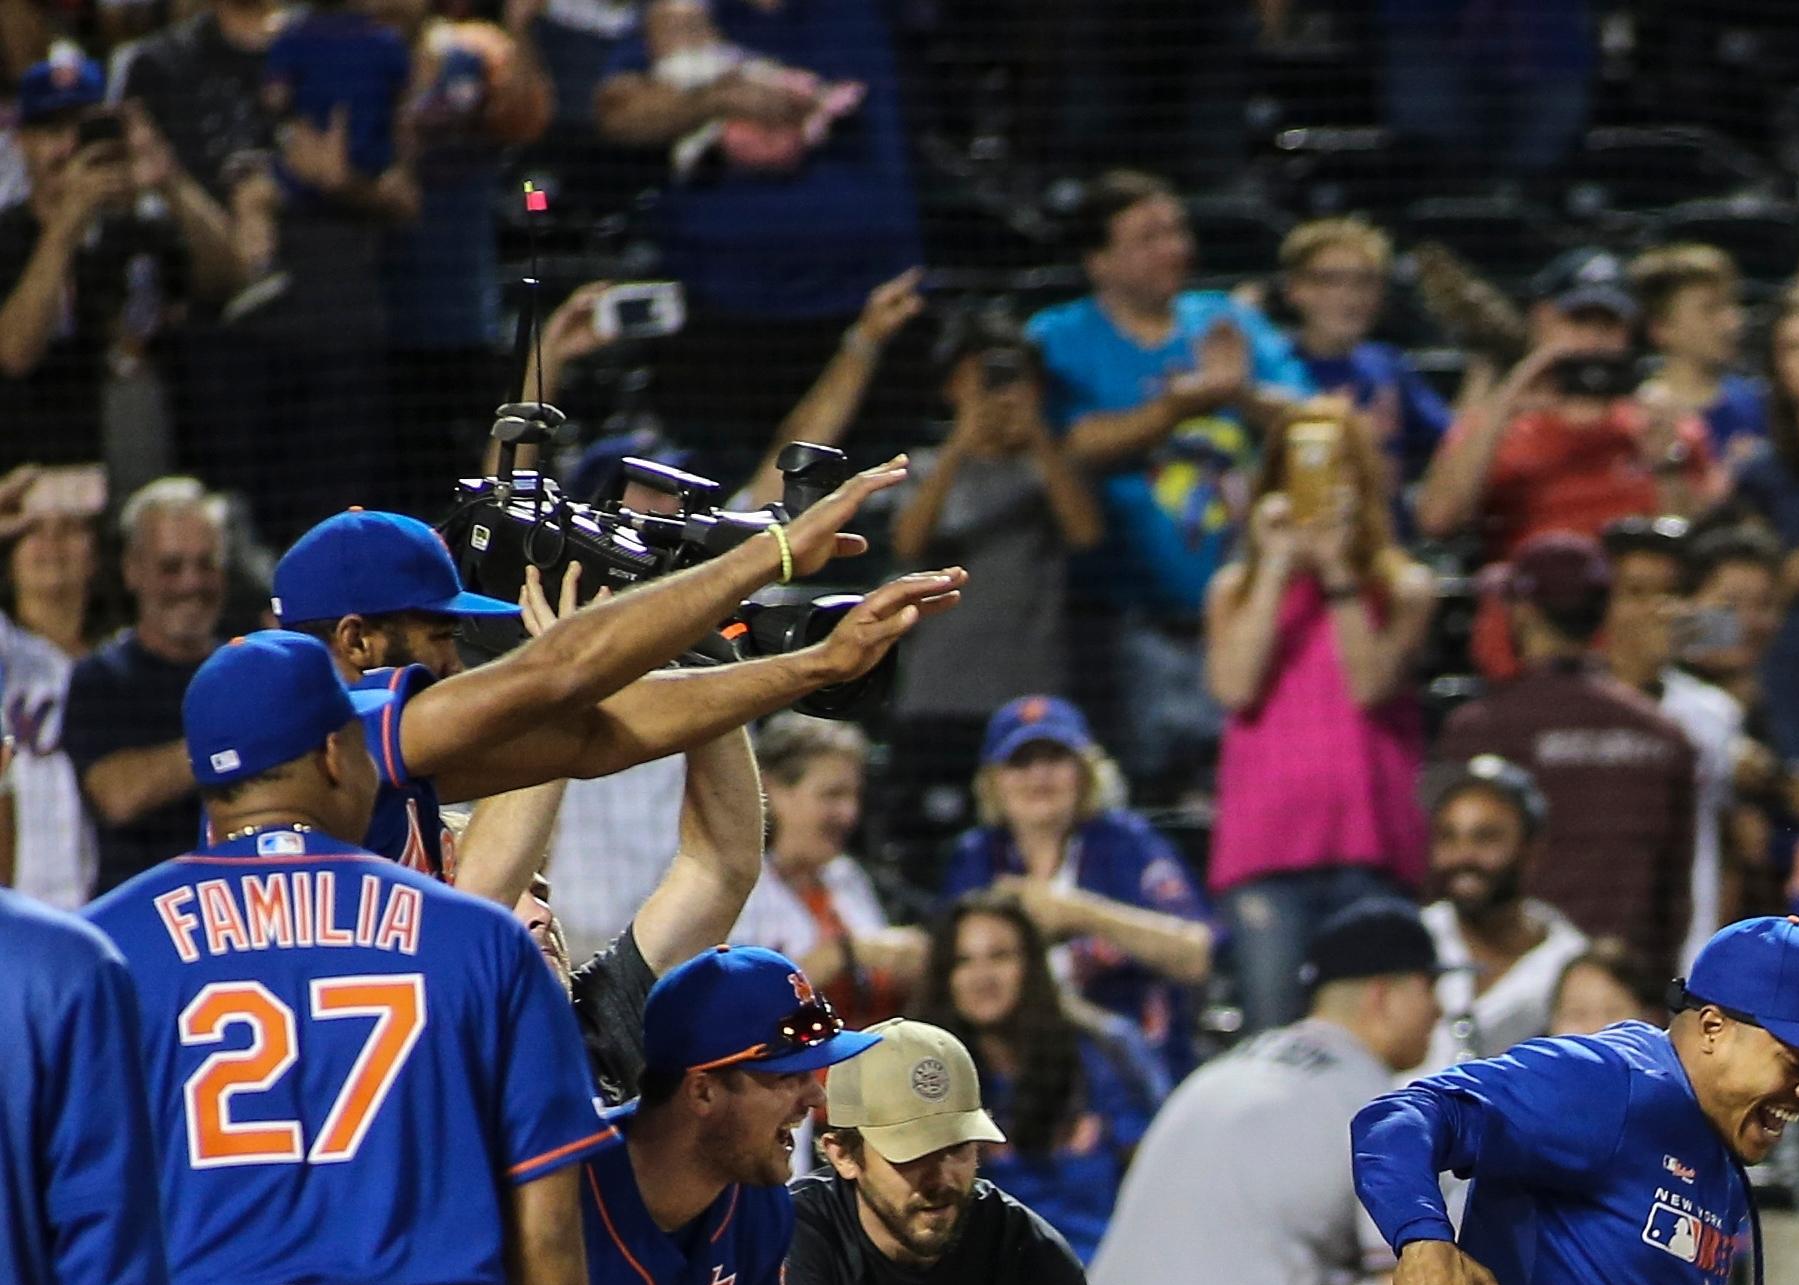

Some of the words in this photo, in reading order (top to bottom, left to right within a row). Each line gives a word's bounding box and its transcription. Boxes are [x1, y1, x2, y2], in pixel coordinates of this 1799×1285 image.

[607, 566, 638, 582] SONY
[153, 869, 424, 964] FAMILIA
[177, 973, 429, 1171] 27
[1654, 1187, 1693, 1213] NEW
